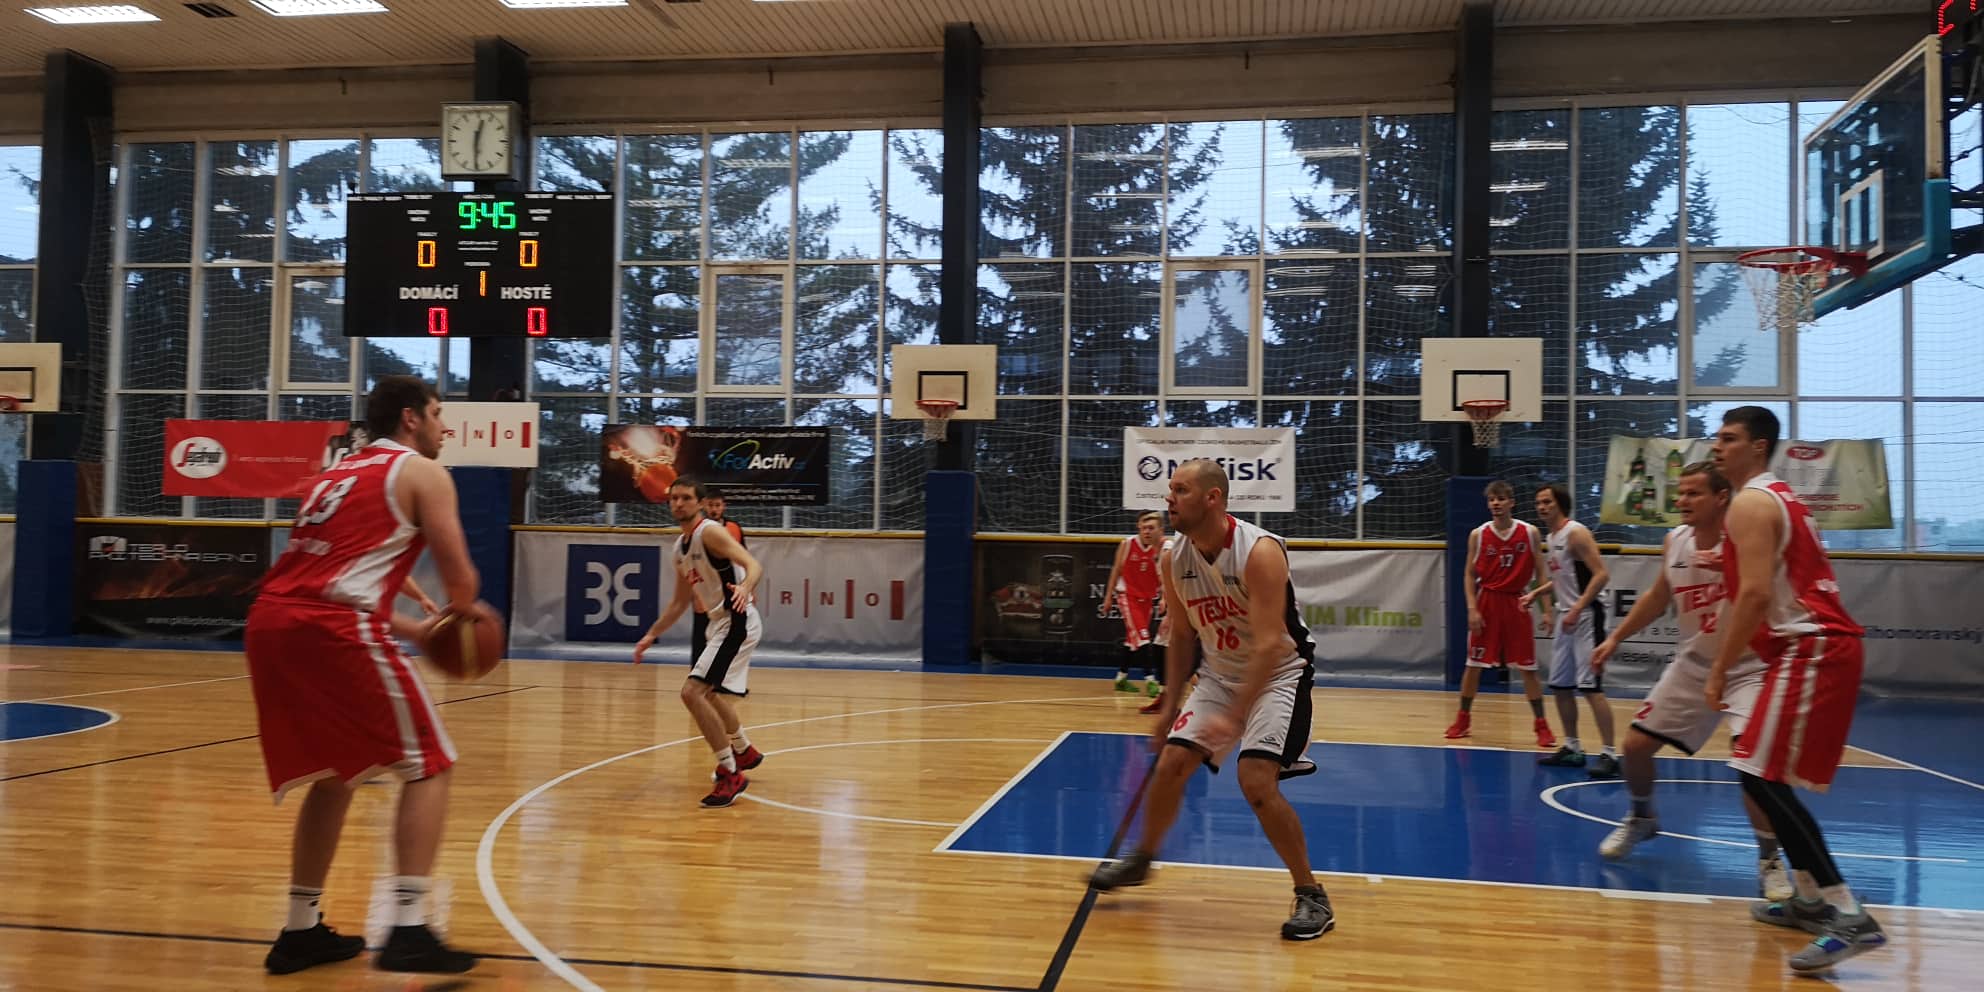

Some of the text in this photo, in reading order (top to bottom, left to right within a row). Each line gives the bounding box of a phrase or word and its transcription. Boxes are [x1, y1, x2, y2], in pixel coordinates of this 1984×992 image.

[458, 201, 517, 230] 9:45
[417, 240, 436, 267] 0
[519, 239, 538, 267] 0
[399, 284, 459, 300] DOMÁCÍ
[500, 283, 552, 300] HOSTÉ
[428, 307, 448, 336] 0
[527, 307, 546, 337] 0
[1344, 605, 1423, 628] Klima
[1216, 625, 1240, 651] 16
